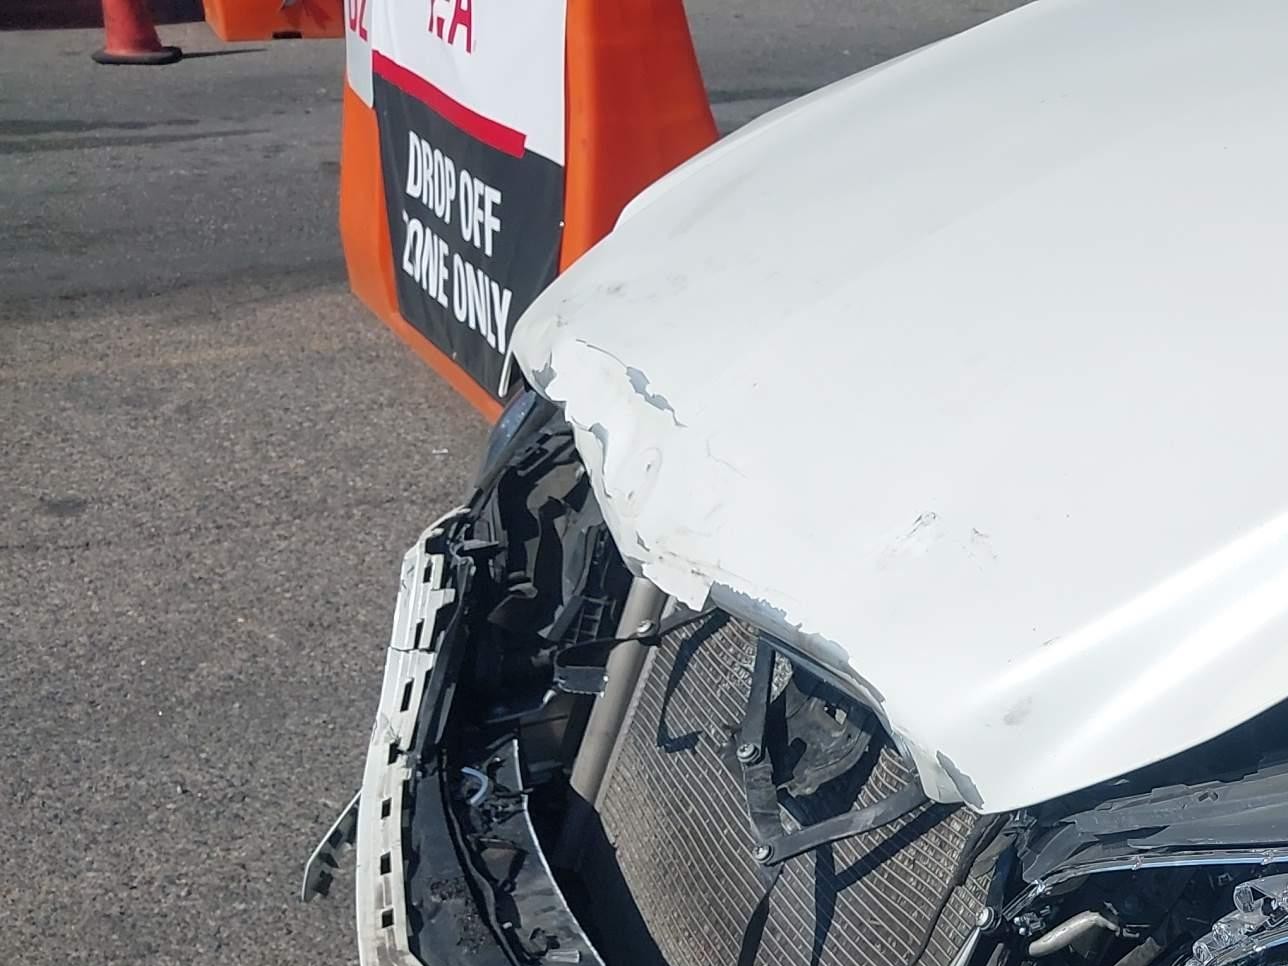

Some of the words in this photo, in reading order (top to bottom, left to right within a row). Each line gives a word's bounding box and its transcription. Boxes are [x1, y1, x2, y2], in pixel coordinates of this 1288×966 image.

[406, 130, 456, 225] DROP
[460, 169, 502, 257] OFF
[453, 253, 512, 355] ONLY
